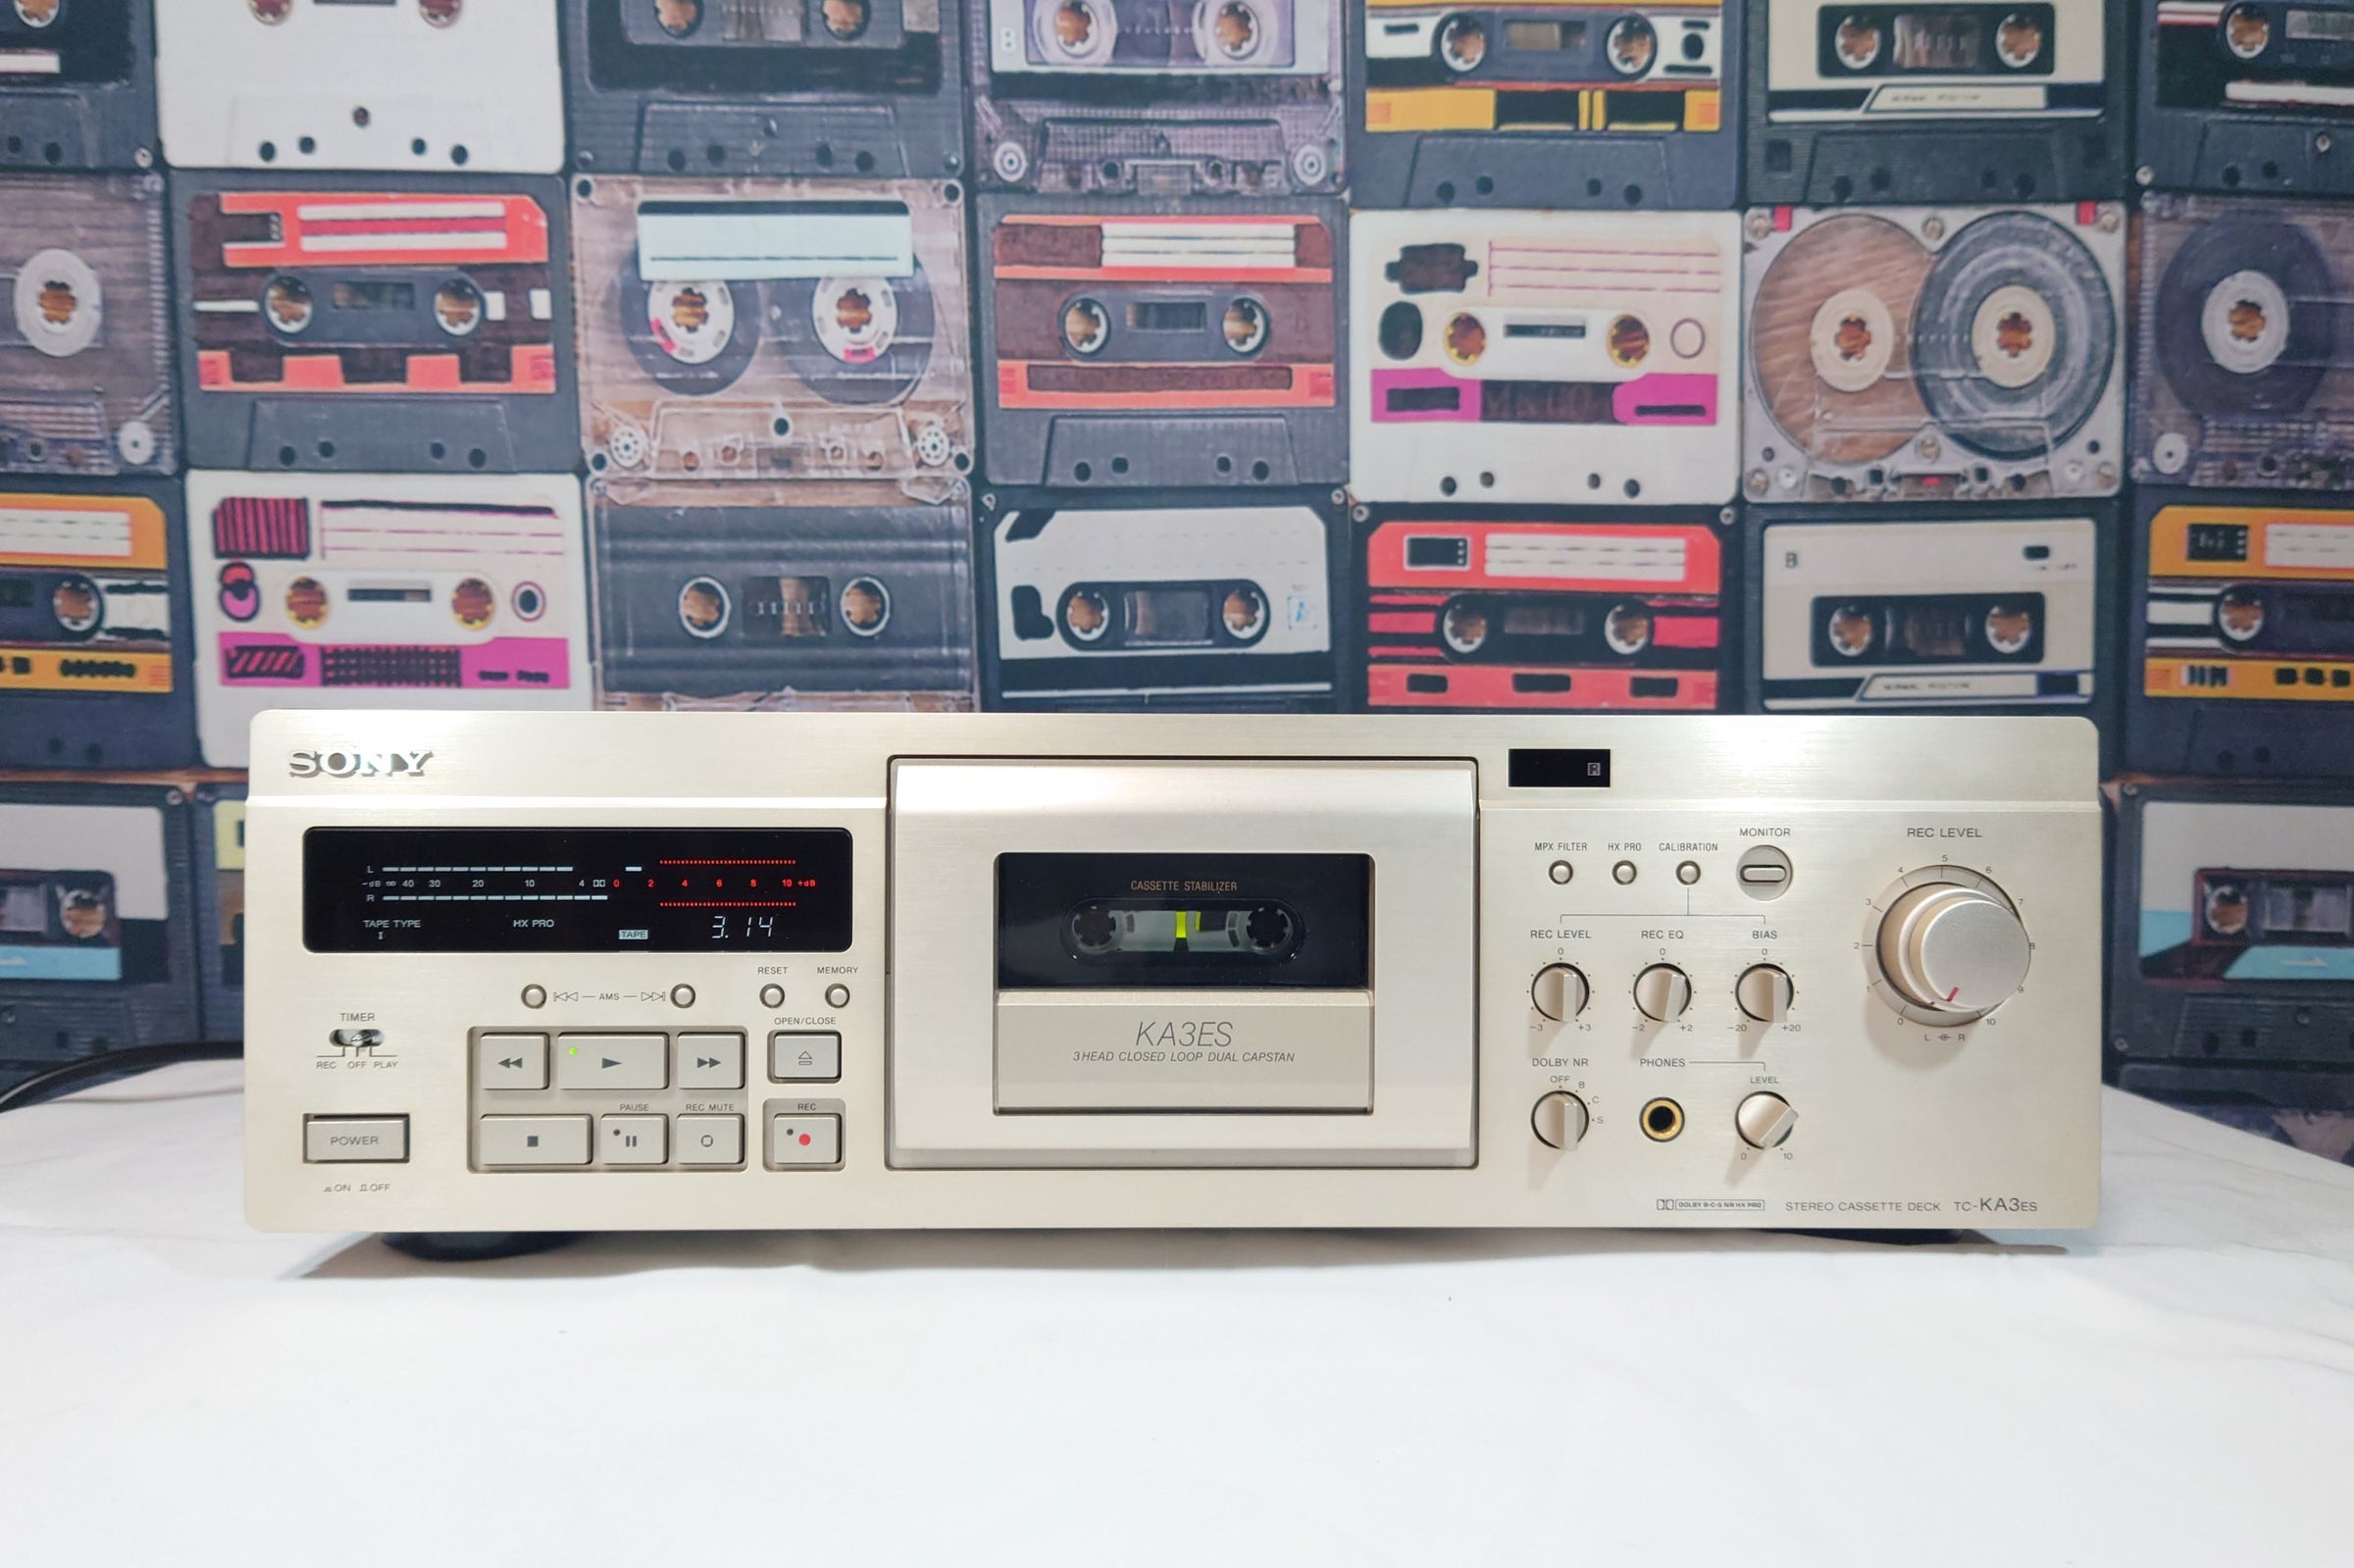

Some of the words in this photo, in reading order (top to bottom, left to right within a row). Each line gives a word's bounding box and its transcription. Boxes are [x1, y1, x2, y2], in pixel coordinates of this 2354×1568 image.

[289, 749, 434, 778] SONY
[1739, 828, 1791, 837] MONITOR
[1907, 828, 1934, 837] REC
[1940, 828, 1982, 837] LEVEL
[1534, 842, 1554, 852] MPX
[1558, 842, 1588, 852] FILTER
[1608, 842, 1620, 852] HX
[1624, 842, 1642, 852] PRO
[1659, 842, 1718, 852] CALIBRATION
[1131, 881, 1179, 891] CASSETTE
[1184, 881, 1238, 891] STABILIZER
[363, 920, 389, 929] TAPE
[392, 920, 422, 929] TYPE
[513, 919, 529, 928] HX
[532, 919, 555, 928] PRO
[712, 915, 774, 938] 3.14
[1530, 930, 1555, 939] REC
[1558, 930, 1592, 939] LEVEL
[1641, 930, 1665, 939] REC
[1668, 930, 1685, 939] EQ
[1752, 930, 1777, 939] BIAS
[1558, 947, 1564, 956] 0
[1660, 947, 1666, 956] 0
[1762, 947, 1768, 956] 0
[757, 966, 789, 975] RESET
[816, 966, 858, 975] MEMORY
[339, 1012, 376, 1022] TIMER
[774, 1017, 837, 1026] OPEN/CLOSE
[1135, 1022, 1234, 1047] KA3ES
[1118, 1051, 1166, 1062] CLOSED
[1170, 1051, 1203, 1062] LOOP
[1207, 1051, 1239, 1062] DUAL
[1242, 1051, 1295, 1062] CAPSTAN
[1532, 1058, 1569, 1068] DOLBY
[1572, 1058, 1589, 1068] NR
[1639, 1058, 1686, 1068] PHONES
[1578, 1081, 1585, 1089] B
[1750, 1076, 1779, 1085] LEVEL
[1592, 1095, 1600, 1104] C
[619, 1103, 649, 1112] PAUSE
[686, 1103, 705, 1112] REC
[708, 1103, 735, 1112] MUTE
[1597, 1116, 1604, 1125] S
[330, 1136, 380, 1145] POWER
[1740, 1152, 1747, 1161] 0
[1783, 1152, 1793, 1161] 10
[333, 1184, 351, 1192] ON
[369, 1184, 390, 1192] OFF
[1785, 1201, 1834, 1211] STEREO
[1838, 1201, 1903, 1211] CASSETTE
[1908, 1201, 1941, 1211] DECK
[1954, 1197, 2038, 1212] TC-KA3ES
